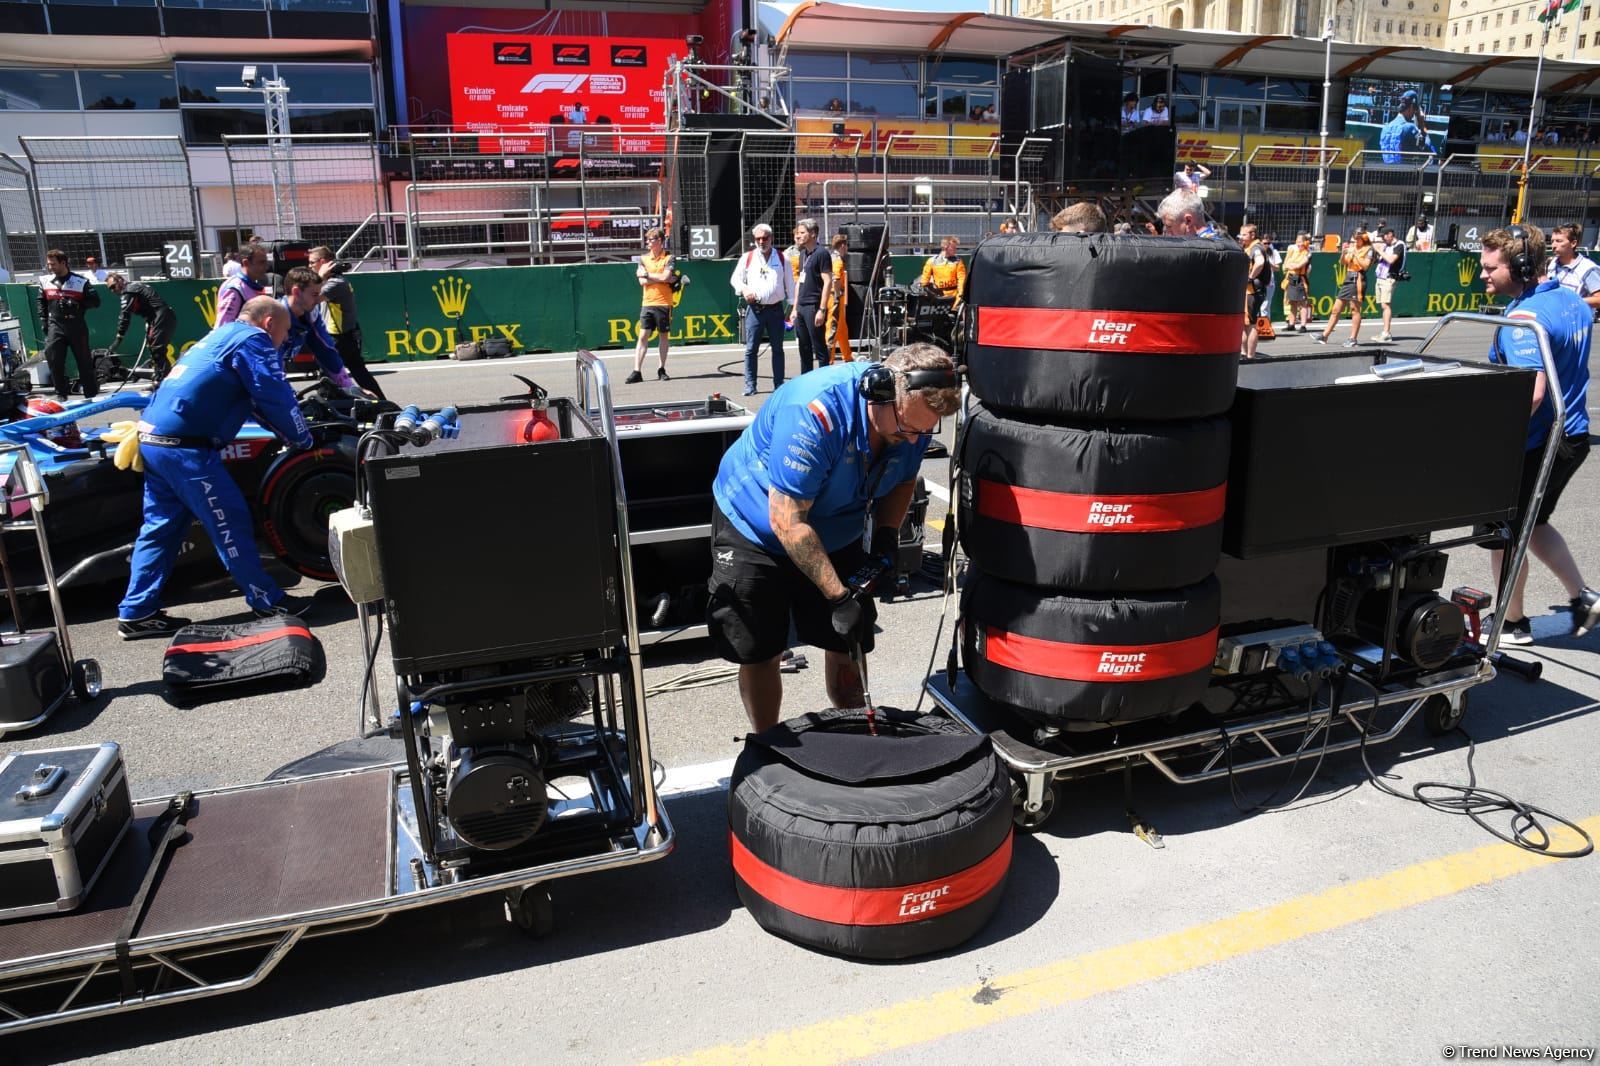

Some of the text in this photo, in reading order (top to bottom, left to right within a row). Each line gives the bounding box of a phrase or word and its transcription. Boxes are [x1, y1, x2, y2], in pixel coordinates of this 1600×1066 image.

[464, 86, 496, 95] Emirates
[691, 228, 717, 245] 31
[1465, 227, 1478, 240] 4
[692, 248, 715, 257] OCO
[1460, 242, 1480, 250] NOR
[164, 244, 193, 263] 24
[1307, 295, 1378, 316] ROX
[1427, 292, 1496, 312] ROLEX
[1092, 318, 1136, 332] Rear
[385, 324, 524, 356] ROLEX
[1088, 332, 1128, 344] Left
[1090, 502, 1132, 513] Rear
[200, 480, 240, 558] ALPINE
[1087, 513, 1135, 526] Right
[1100, 652, 1146, 662] Front
[1097, 662, 1142, 676] Right
[901, 885, 950, 904] Front
[899, 900, 936, 916] Left
